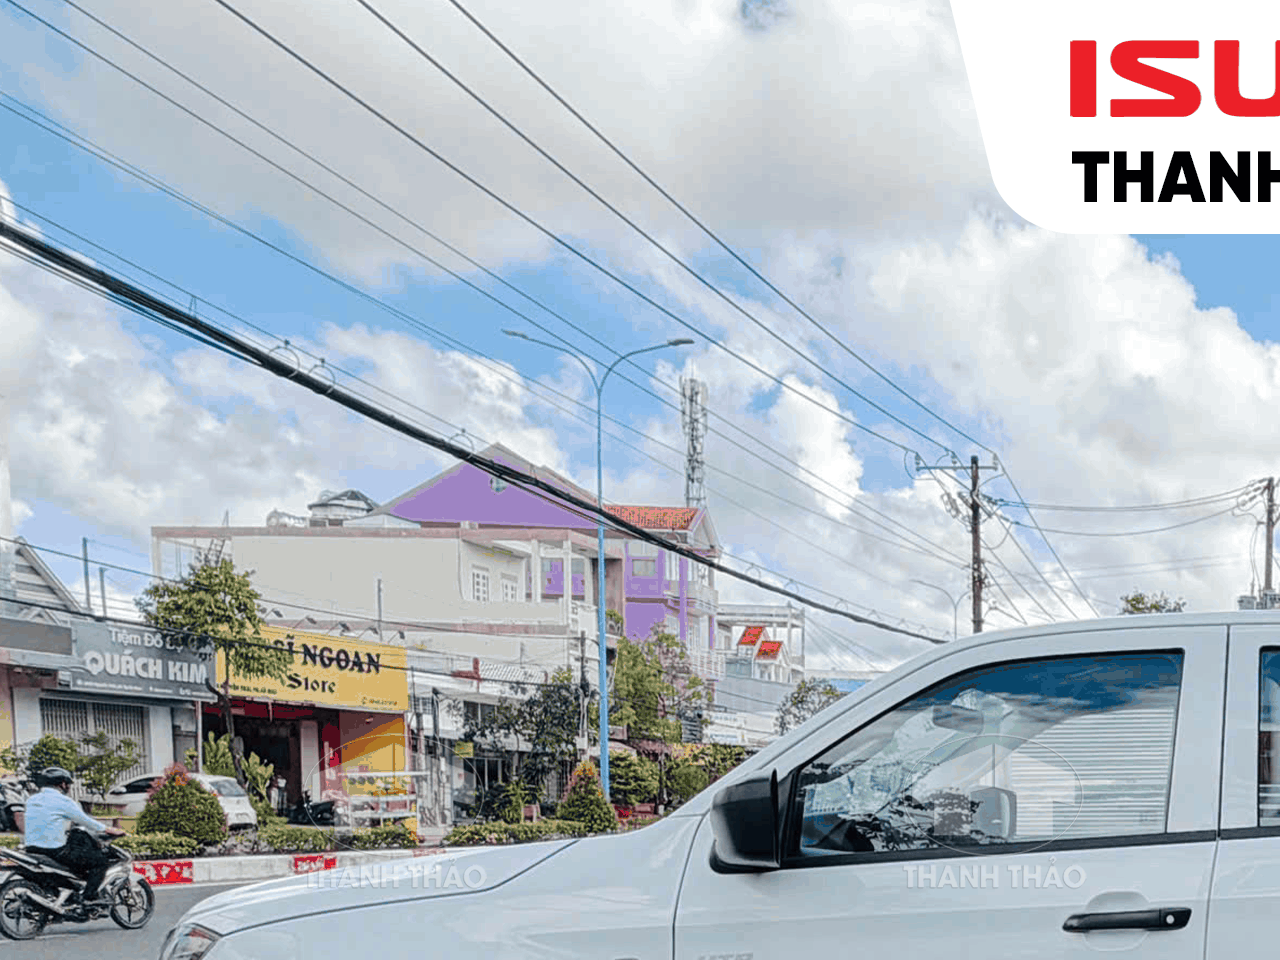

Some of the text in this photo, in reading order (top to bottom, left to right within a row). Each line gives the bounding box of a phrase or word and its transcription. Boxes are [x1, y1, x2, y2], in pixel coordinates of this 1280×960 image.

[110, 627, 141, 646] Tiệm
[85, 649, 208, 685] QUÁCH KIM
[302, 643, 381, 674] NGOAN
[286, 672, 336, 693] Store
